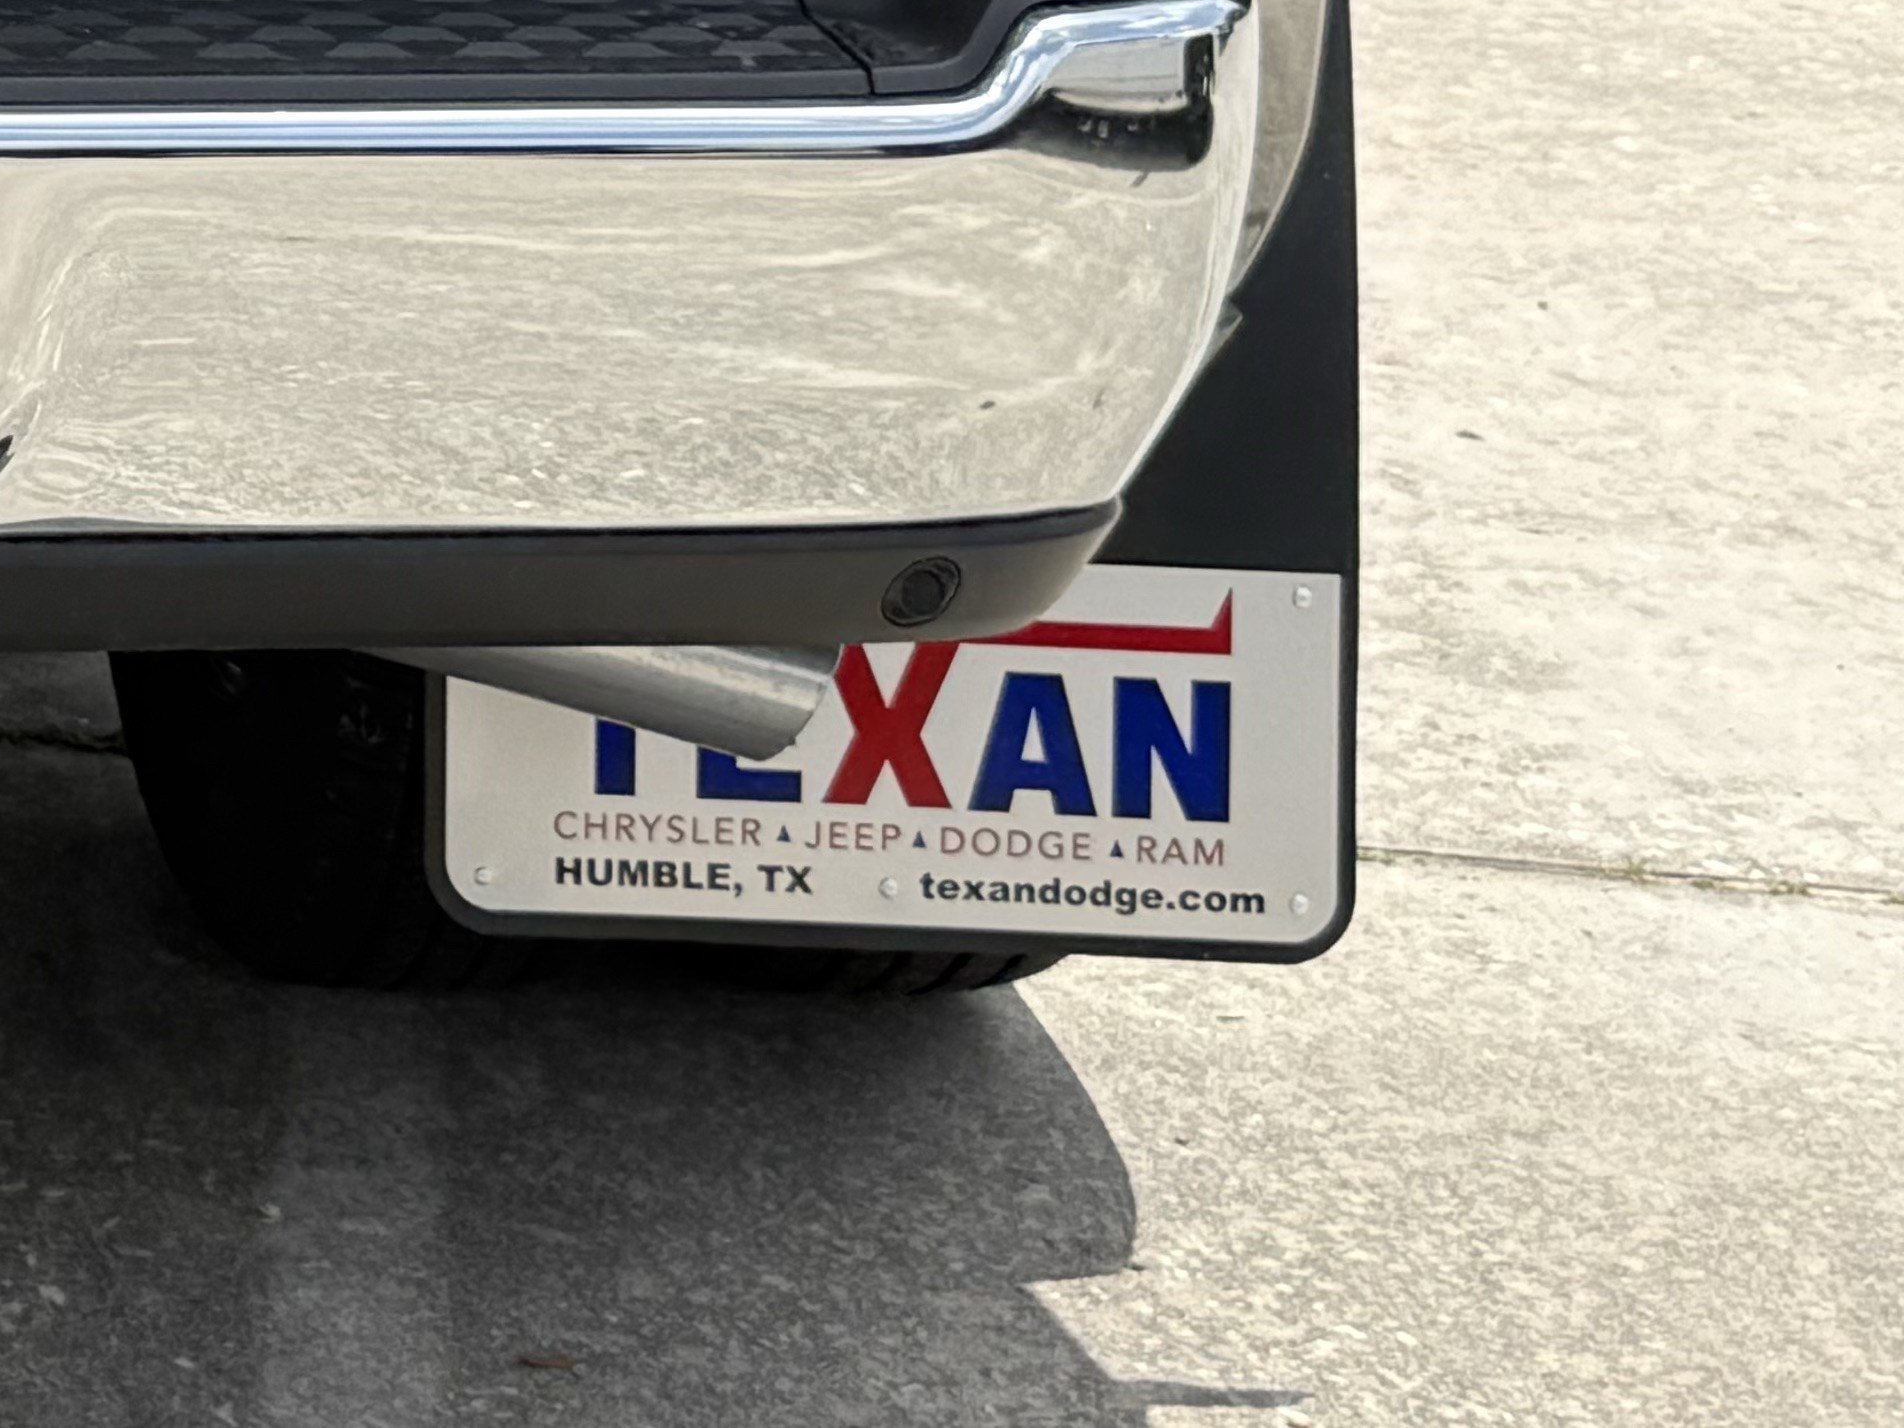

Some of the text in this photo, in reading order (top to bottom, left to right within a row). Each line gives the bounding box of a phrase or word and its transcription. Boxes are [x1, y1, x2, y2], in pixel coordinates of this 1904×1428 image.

[553, 810, 1225, 866] CHRYSLER JEEP DODGE RAM
[555, 856, 813, 898] HUMBLE, TX
[919, 871, 1266, 916] texandodge.com
